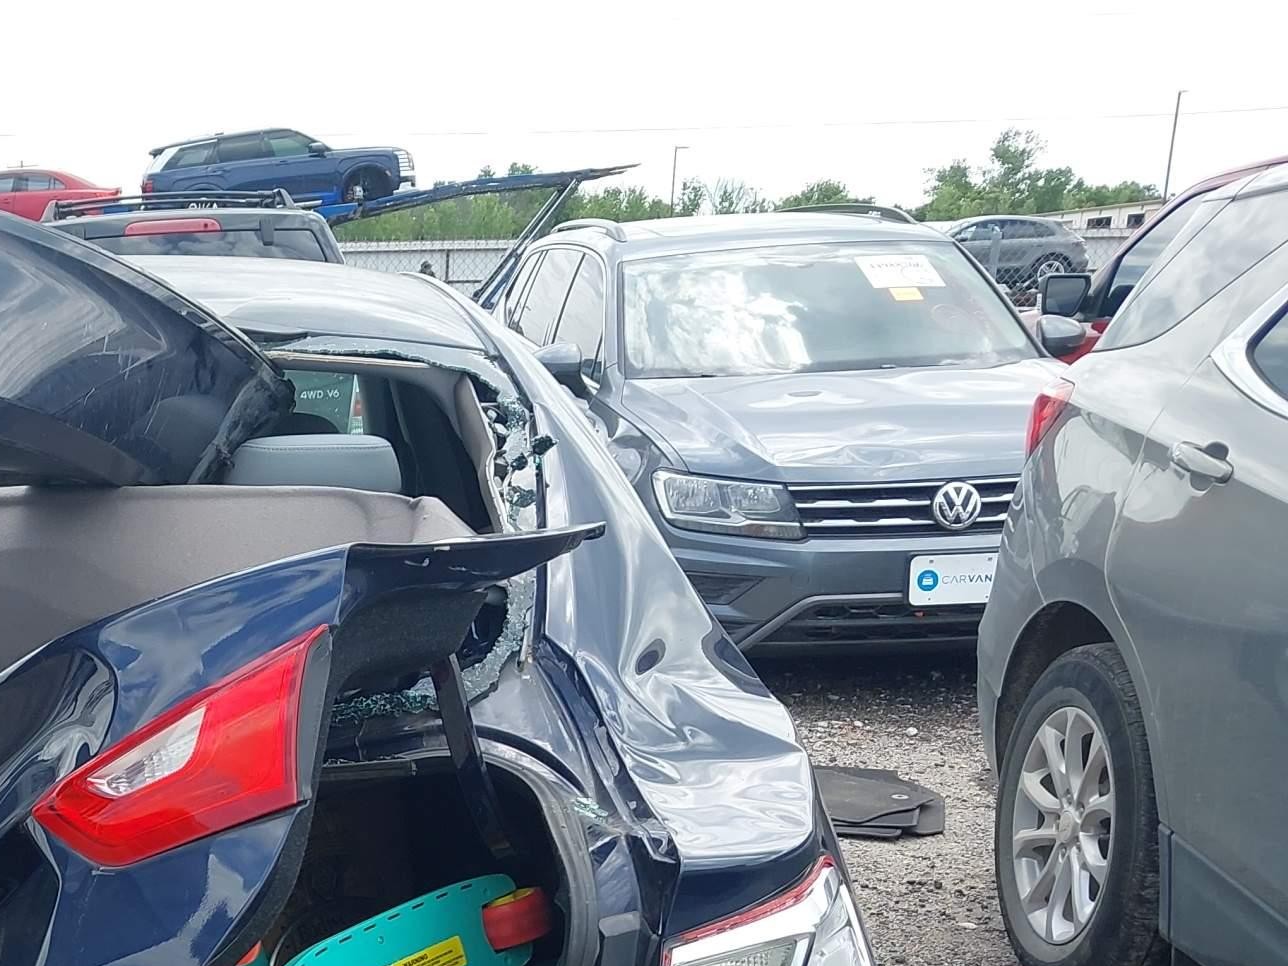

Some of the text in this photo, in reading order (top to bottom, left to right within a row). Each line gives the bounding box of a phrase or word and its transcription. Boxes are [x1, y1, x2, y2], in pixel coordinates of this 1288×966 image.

[300, 389, 340, 399] 4WD V6
[941, 574, 993, 585] CARVAN
